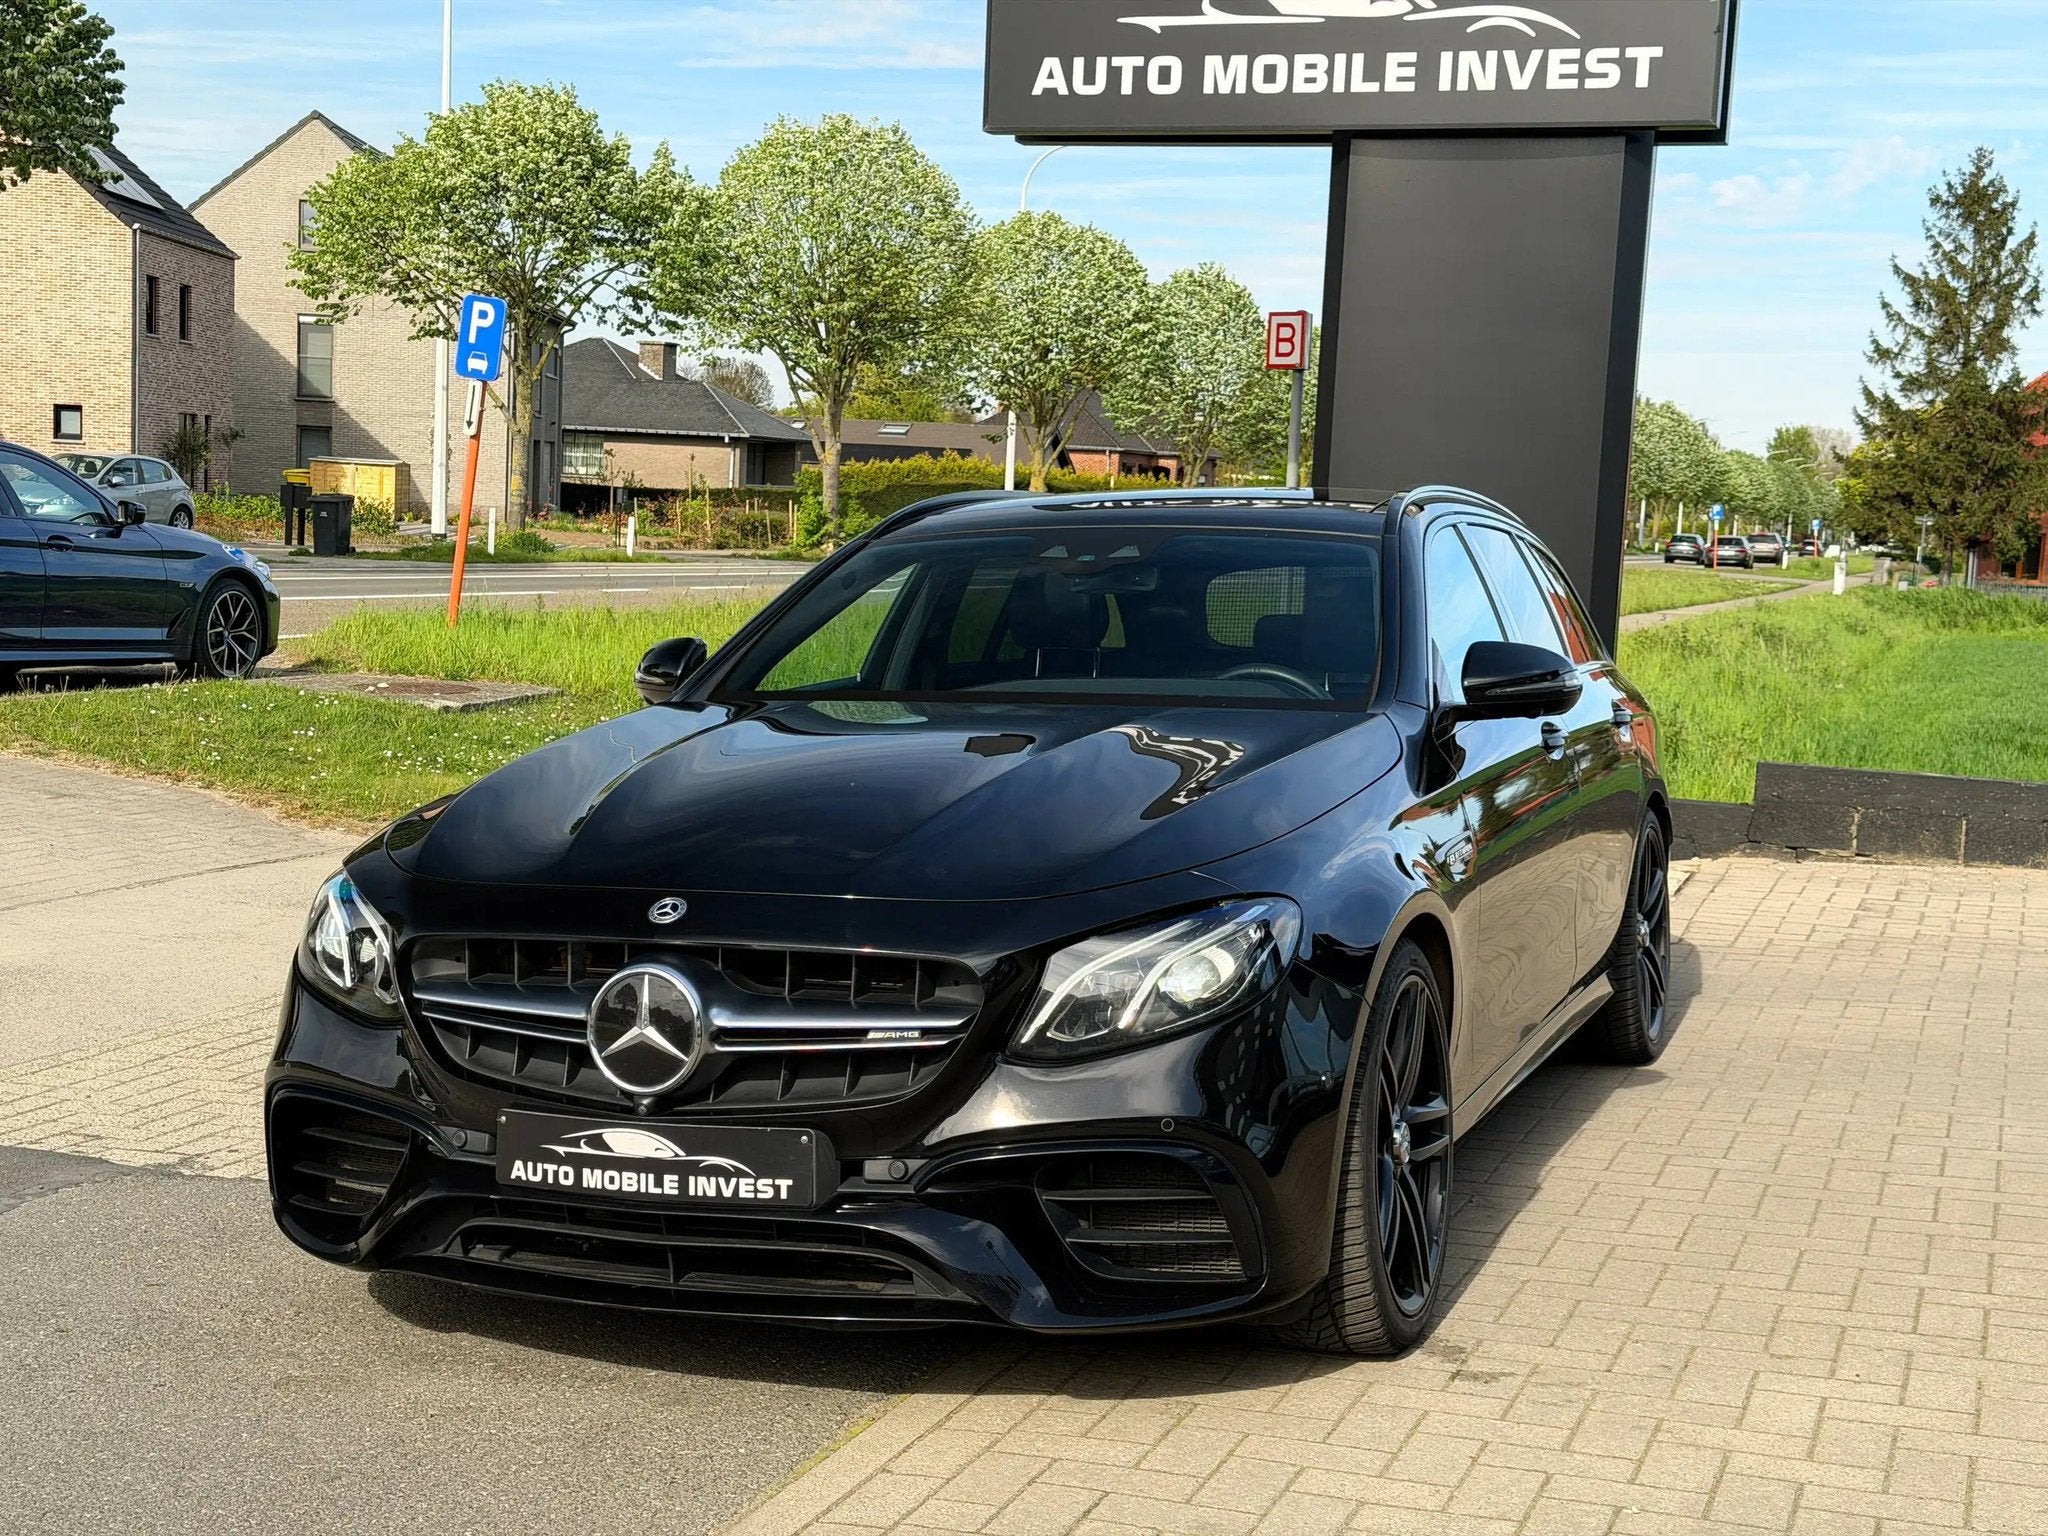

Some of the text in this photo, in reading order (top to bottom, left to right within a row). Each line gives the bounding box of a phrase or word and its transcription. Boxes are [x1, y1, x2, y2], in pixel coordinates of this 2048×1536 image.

[1031, 46, 1664, 96] AUTO MOBILE INVEST
[468, 301, 496, 344] P
[1275, 323, 1296, 357] B
[883, 1031, 919, 1039] AMG
[510, 1160, 794, 1200] AUTO MOBILE INVEST
